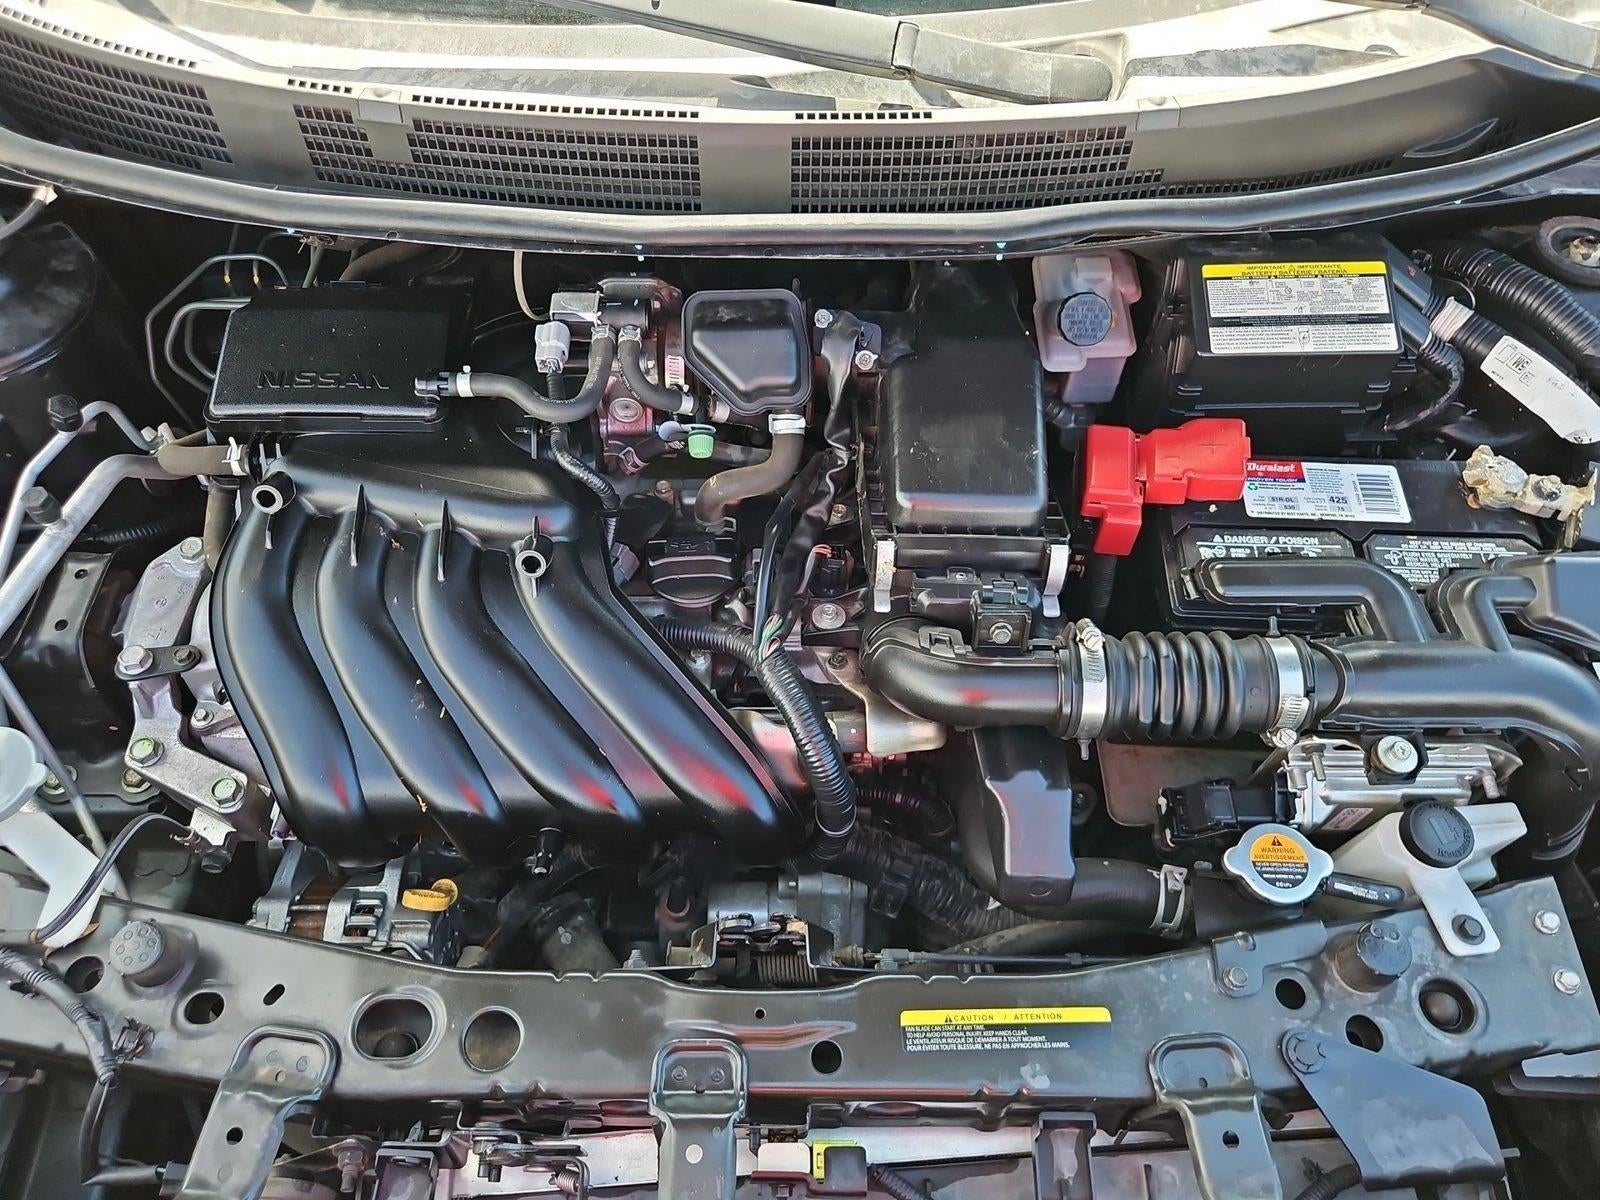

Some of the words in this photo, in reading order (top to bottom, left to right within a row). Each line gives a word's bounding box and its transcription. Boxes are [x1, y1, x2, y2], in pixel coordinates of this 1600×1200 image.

[257, 369, 389, 389] NISSAN
[1246, 462, 1296, 472] Duralast
[1329, 496, 1348, 504] 425
[1224, 535, 1268, 544] DANGER
[1269, 536, 1277, 544] /
[1279, 536, 1319, 545] POISON
[922, 1042, 940, 1050] ÉVITER
